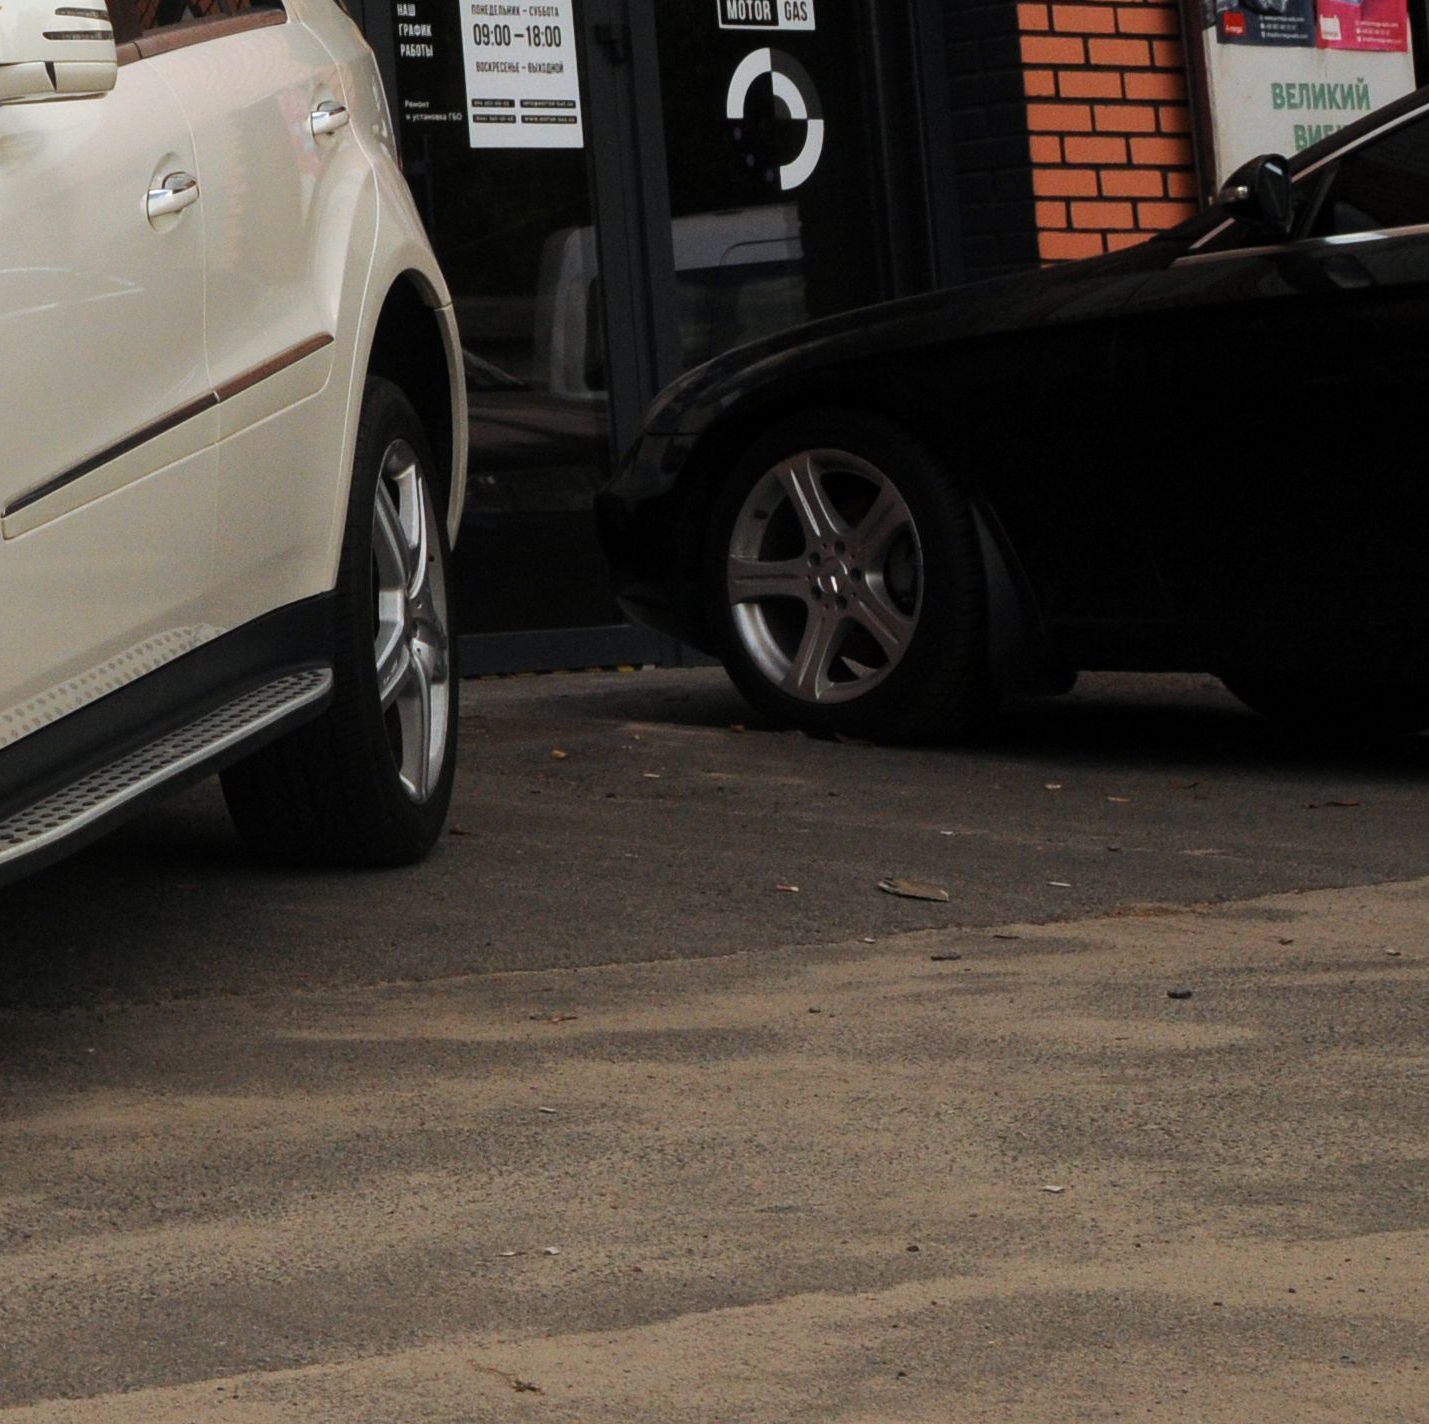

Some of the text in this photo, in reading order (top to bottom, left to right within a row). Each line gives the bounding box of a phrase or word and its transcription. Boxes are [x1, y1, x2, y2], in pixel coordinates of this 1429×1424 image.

[397, 4, 416, 16] НАШ
[471, 4, 520, 16] ПОНЕДЕЛЬНИК
[529, 6, 559, 17] СУББОТА
[726, 0, 808, 21] MOTOR GAS
[398, 24, 432, 36] ГРАФИК
[400, 44, 433, 57] РАБОТЫ
[476, 61, 520, 73] ВОСКРЕСЕНЬЕ
[528, 61, 564, 74] ВЫХОДНОЙ
[1271, 77, 1371, 110] ВЕЛИКИЙ
[448, 112, 462, 120] ГБО
